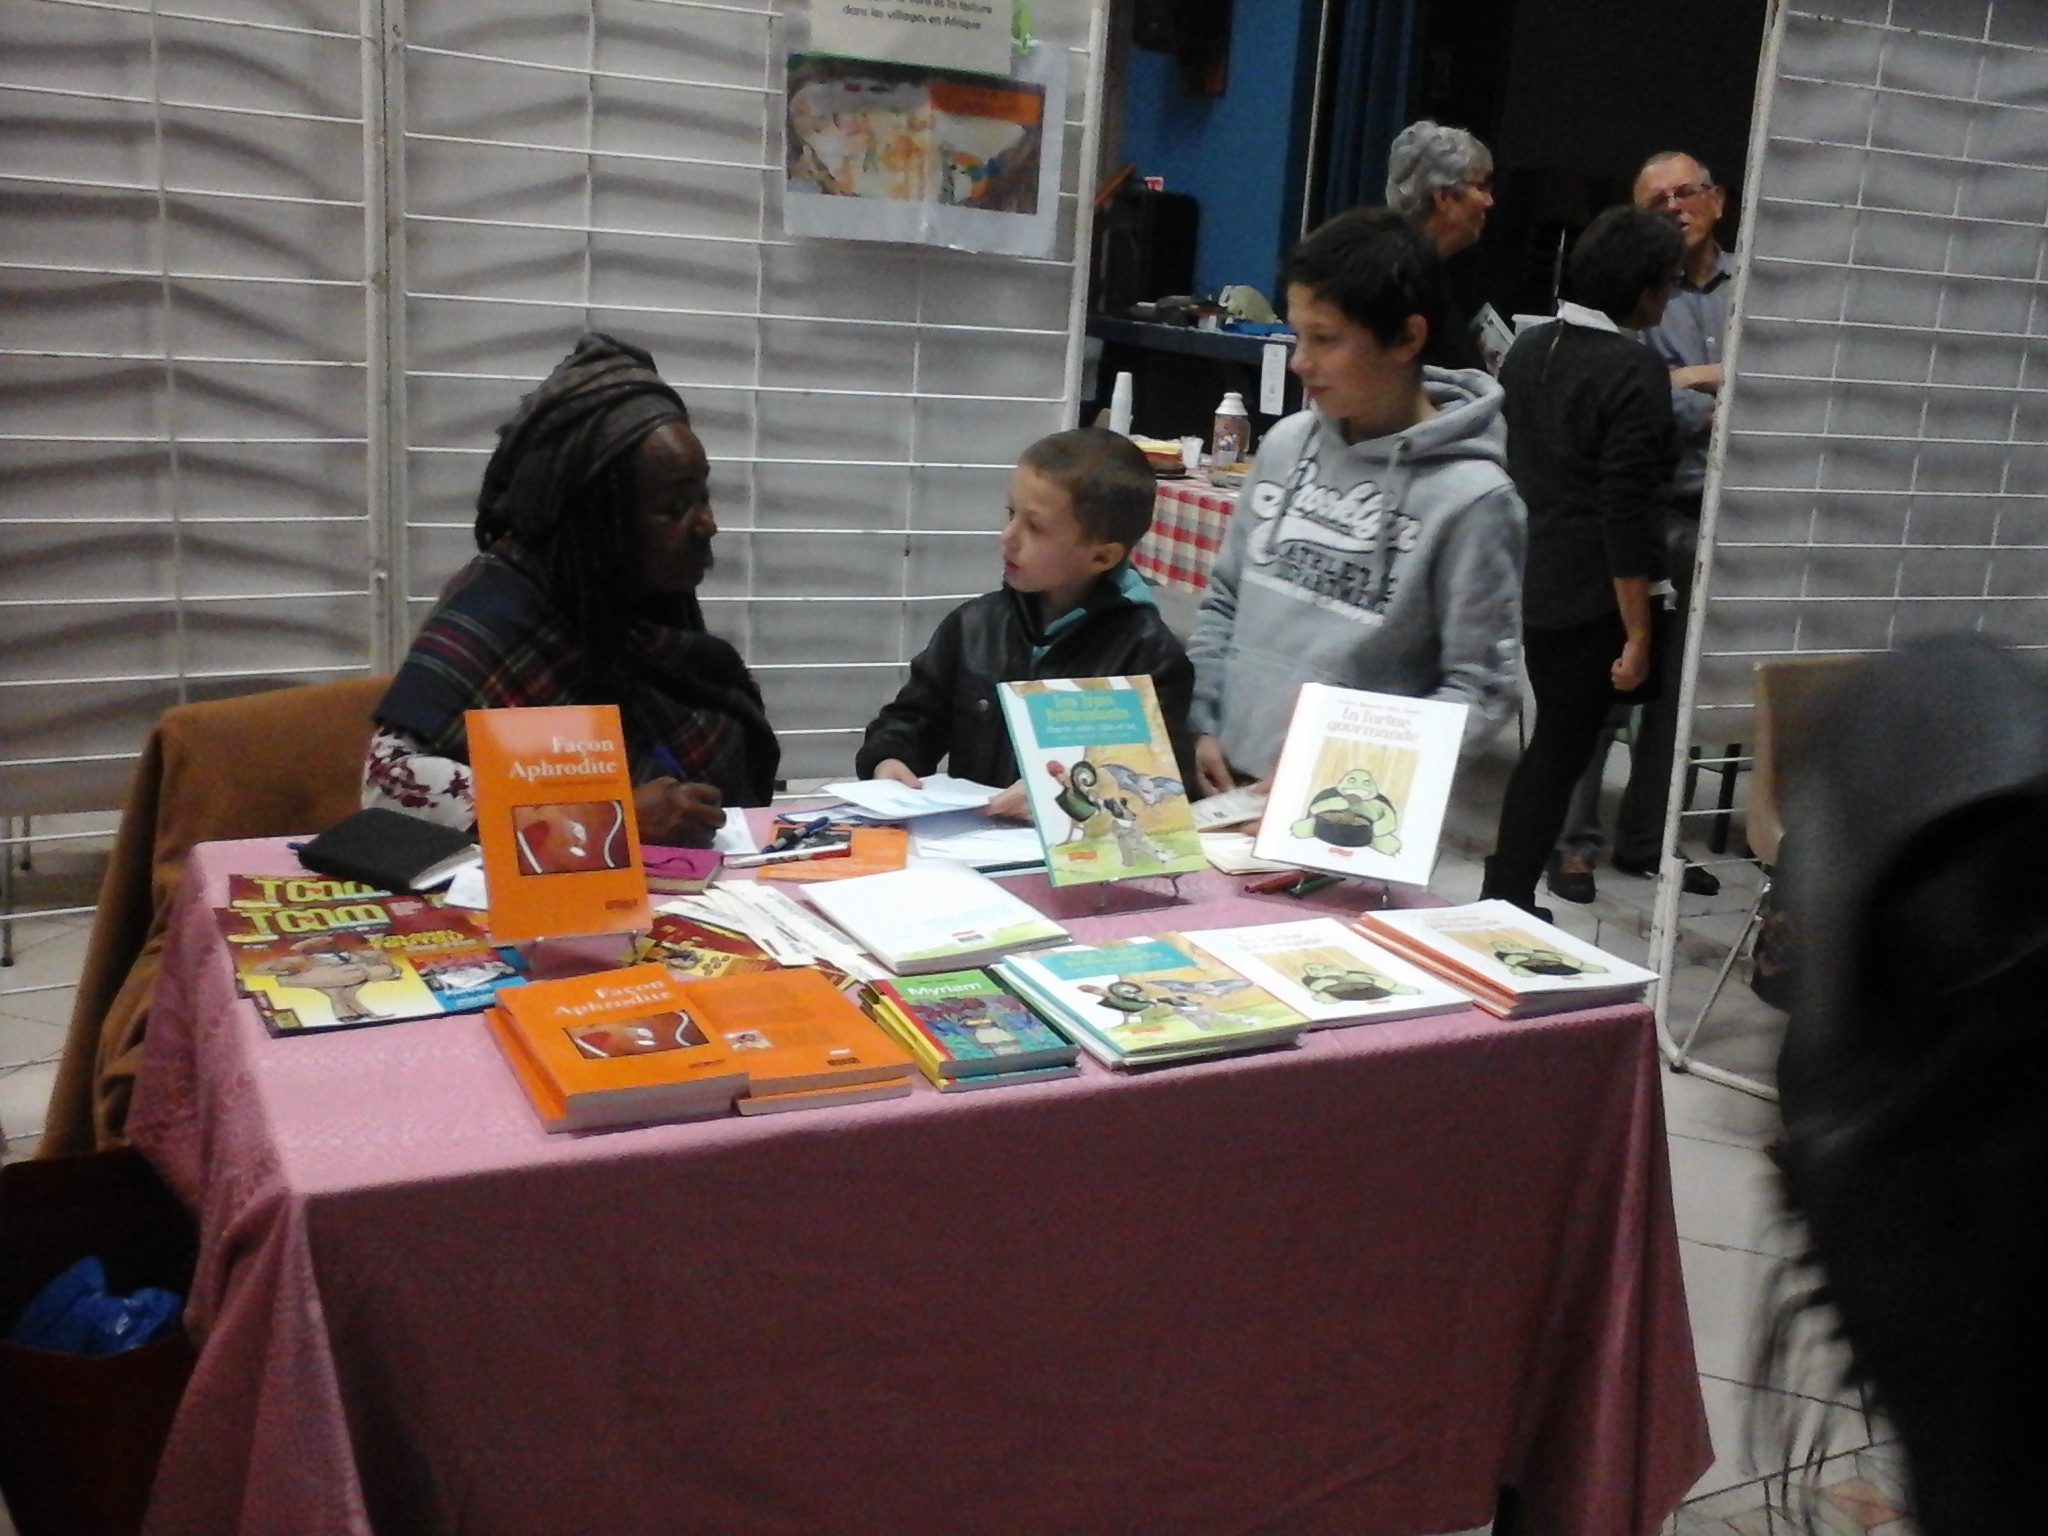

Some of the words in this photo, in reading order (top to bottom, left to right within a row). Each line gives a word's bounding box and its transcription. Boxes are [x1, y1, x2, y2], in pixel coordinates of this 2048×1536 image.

[842, 5, 868, 16] dans
[887, 9, 927, 24] villages
[944, 16, 981, 30] Afrique
[1327, 720, 1420, 743] gourmande
[551, 736, 615, 757] Façon
[508, 759, 618, 783] Aphrodite
[907, 981, 983, 997] Myriam
